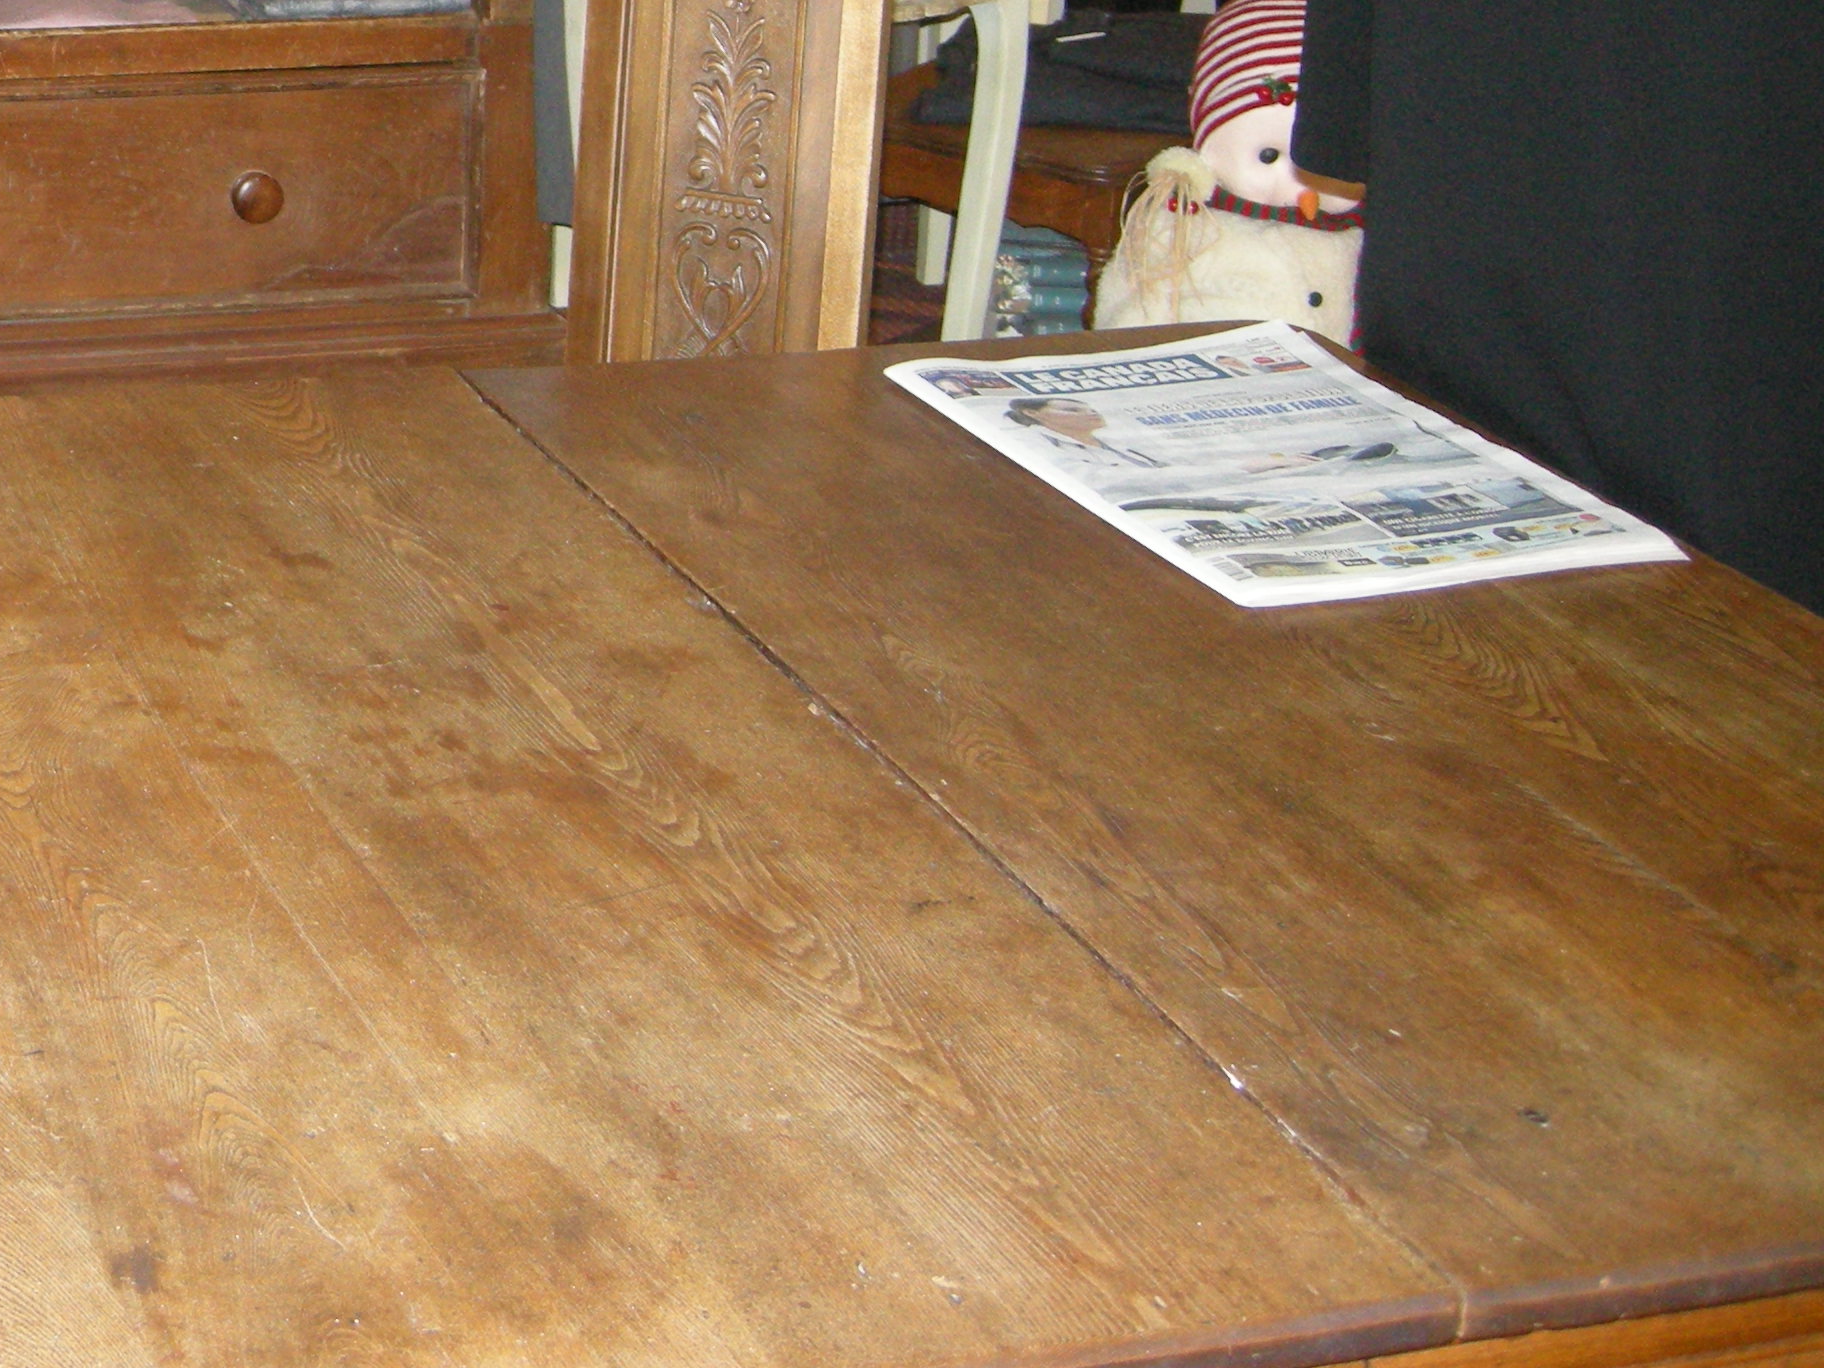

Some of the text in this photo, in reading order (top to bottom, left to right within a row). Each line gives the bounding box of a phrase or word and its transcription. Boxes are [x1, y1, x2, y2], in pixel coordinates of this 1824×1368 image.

[1014, 357, 1202, 384] LE CANADA
[1265, 402, 1292, 414] DE
[1290, 395, 1362, 410] FAMILLE
